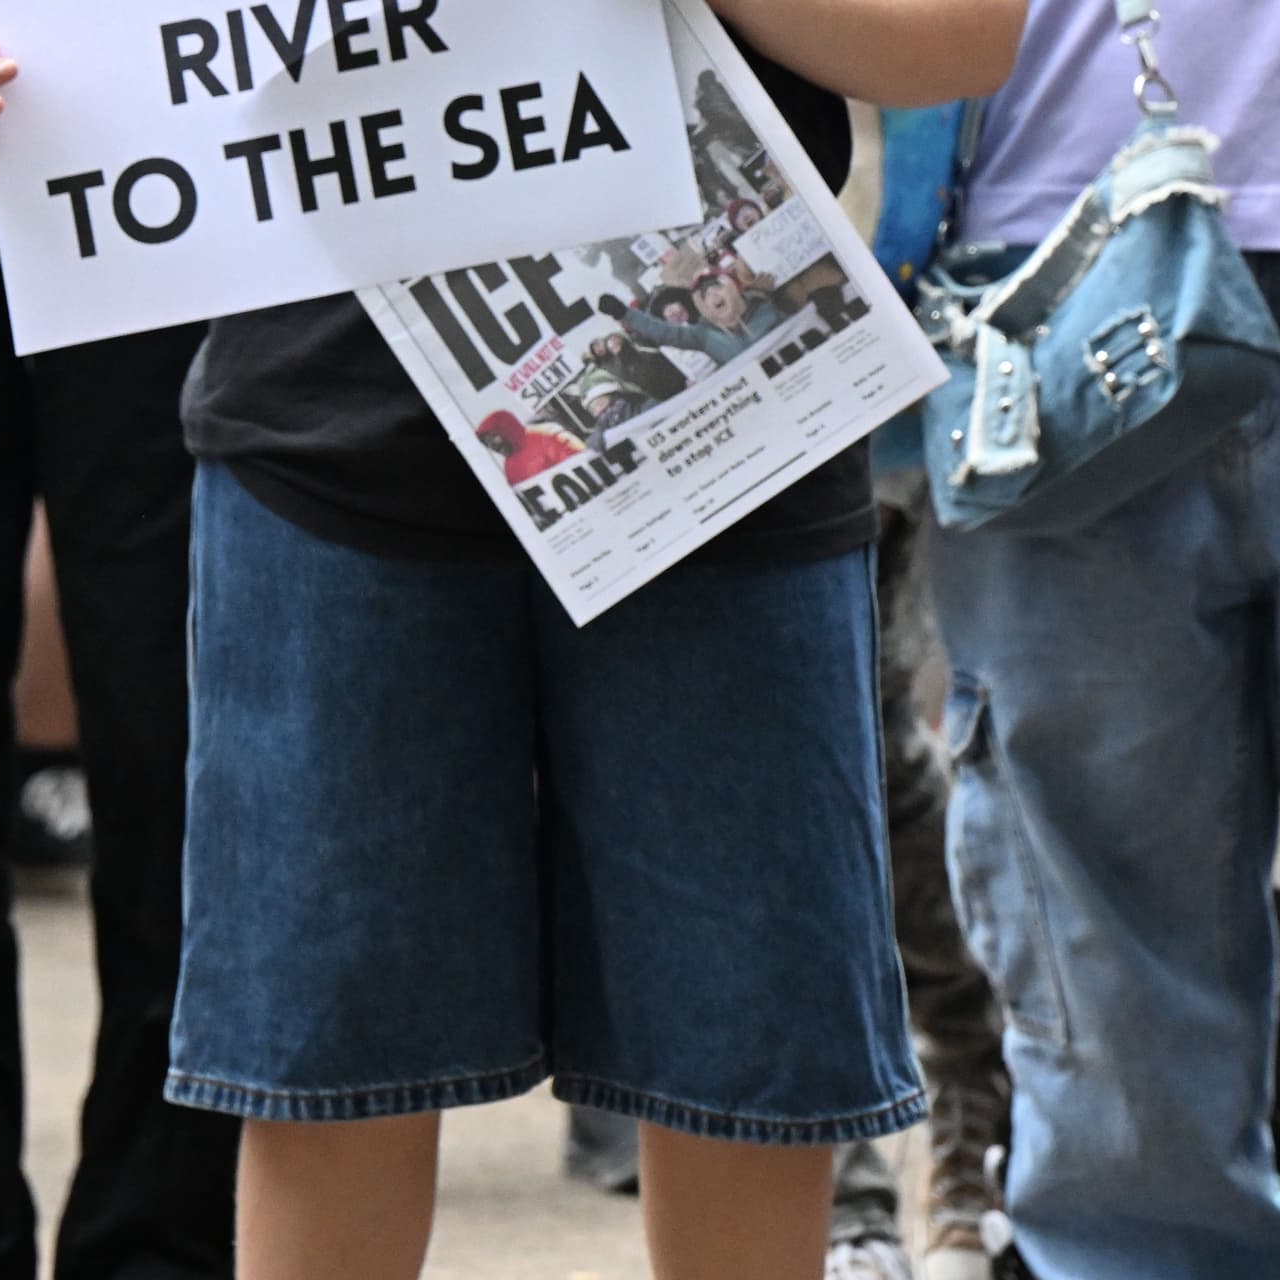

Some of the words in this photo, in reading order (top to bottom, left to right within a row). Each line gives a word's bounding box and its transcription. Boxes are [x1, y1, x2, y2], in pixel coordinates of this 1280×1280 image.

[46, 157, 197, 258] TO
[223, 109, 417, 222] THE
[445, 70, 631, 182] SEA
[409, 252, 595, 392] ICE
[521, 354, 572, 405] SILENT
[647, 432, 666, 449] US
[668, 399, 718, 435] workers
[720, 376, 748, 400] shut
[658, 437, 693, 463] down
[694, 391, 762, 438] everything
[666, 464, 683, 478] to
[685, 444, 713, 467] stop
[713, 426, 735, 446] ICE
